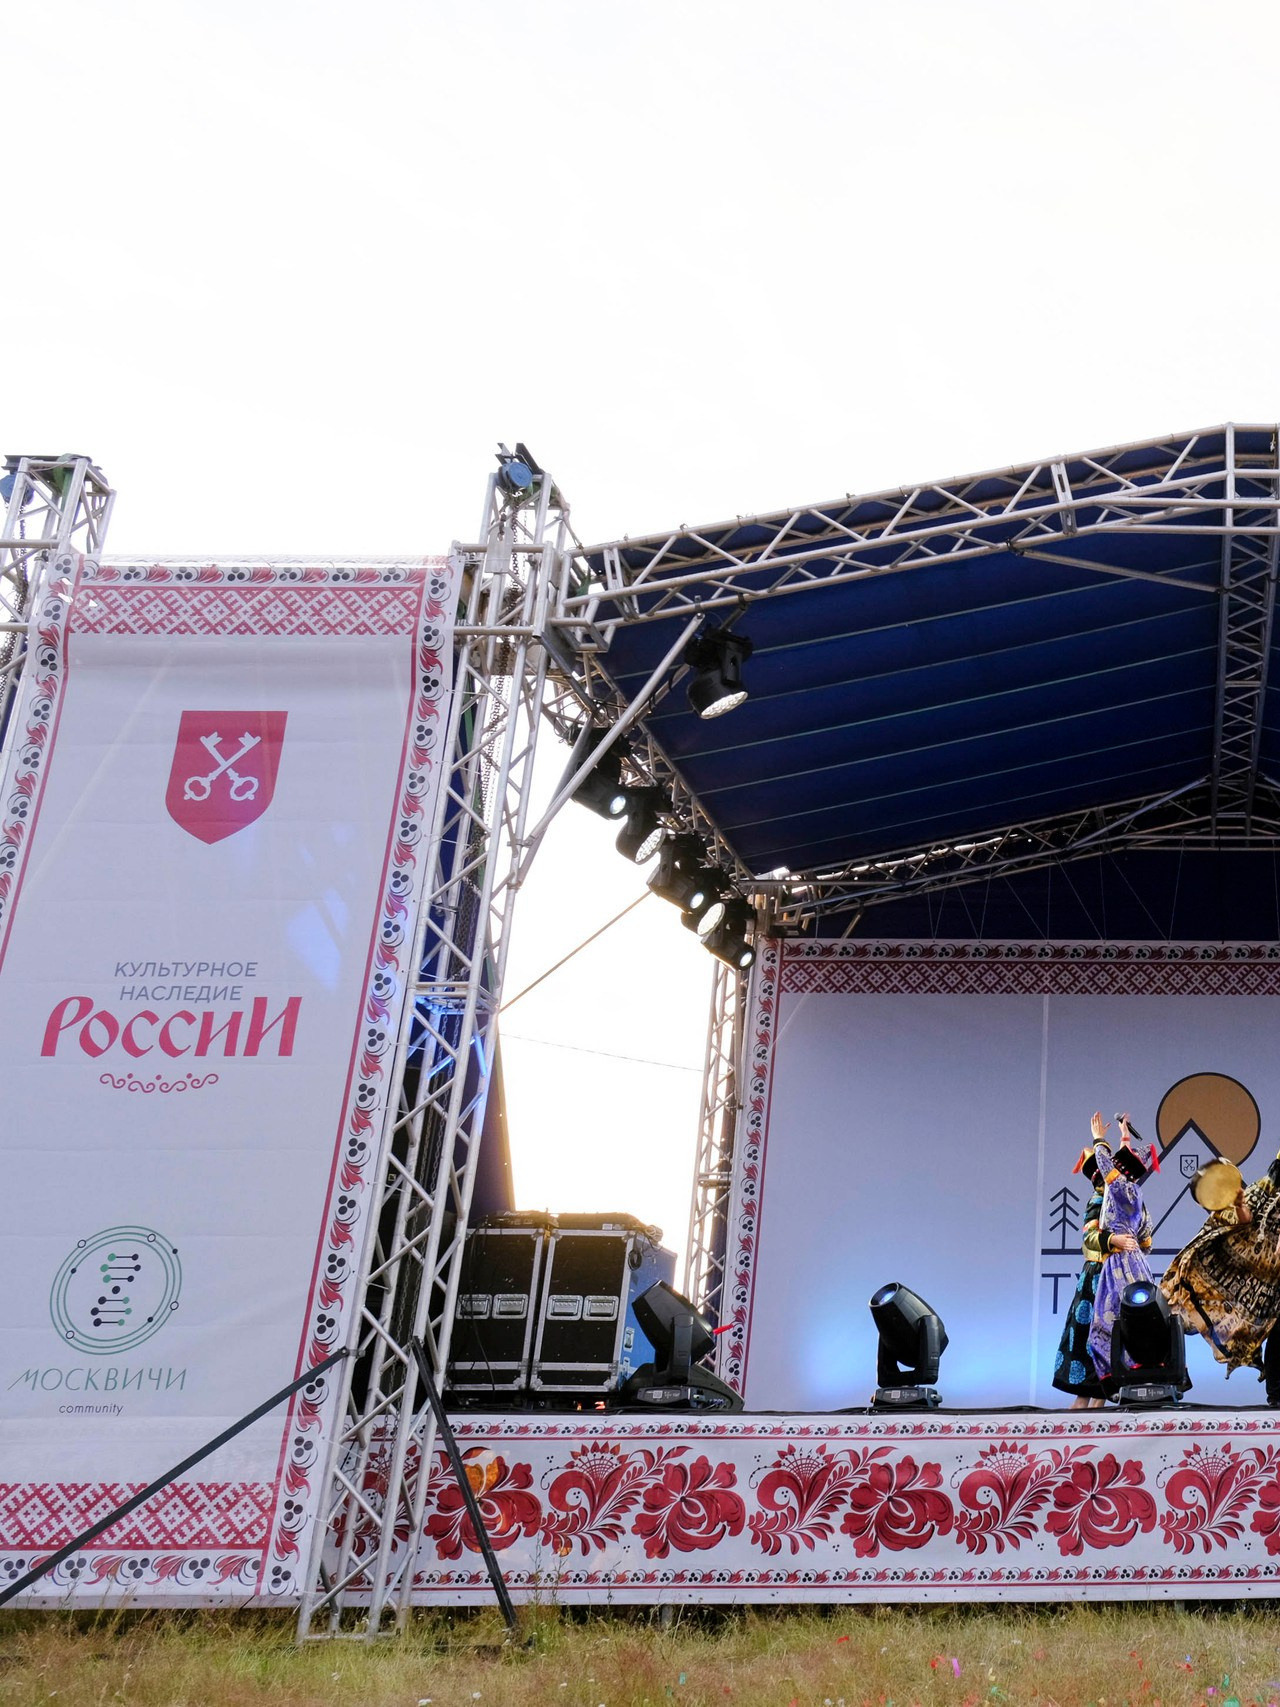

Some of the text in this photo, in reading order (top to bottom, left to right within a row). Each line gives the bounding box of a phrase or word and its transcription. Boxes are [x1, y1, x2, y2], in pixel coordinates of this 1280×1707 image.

[114, 962, 258, 978] КУЛЬТУРНОЕ
[120, 985, 243, 1004] НАСЛЕДИЕ
[7, 1367, 187, 1391] МОСКВИЧИ
[58, 1403, 124, 1416] community
